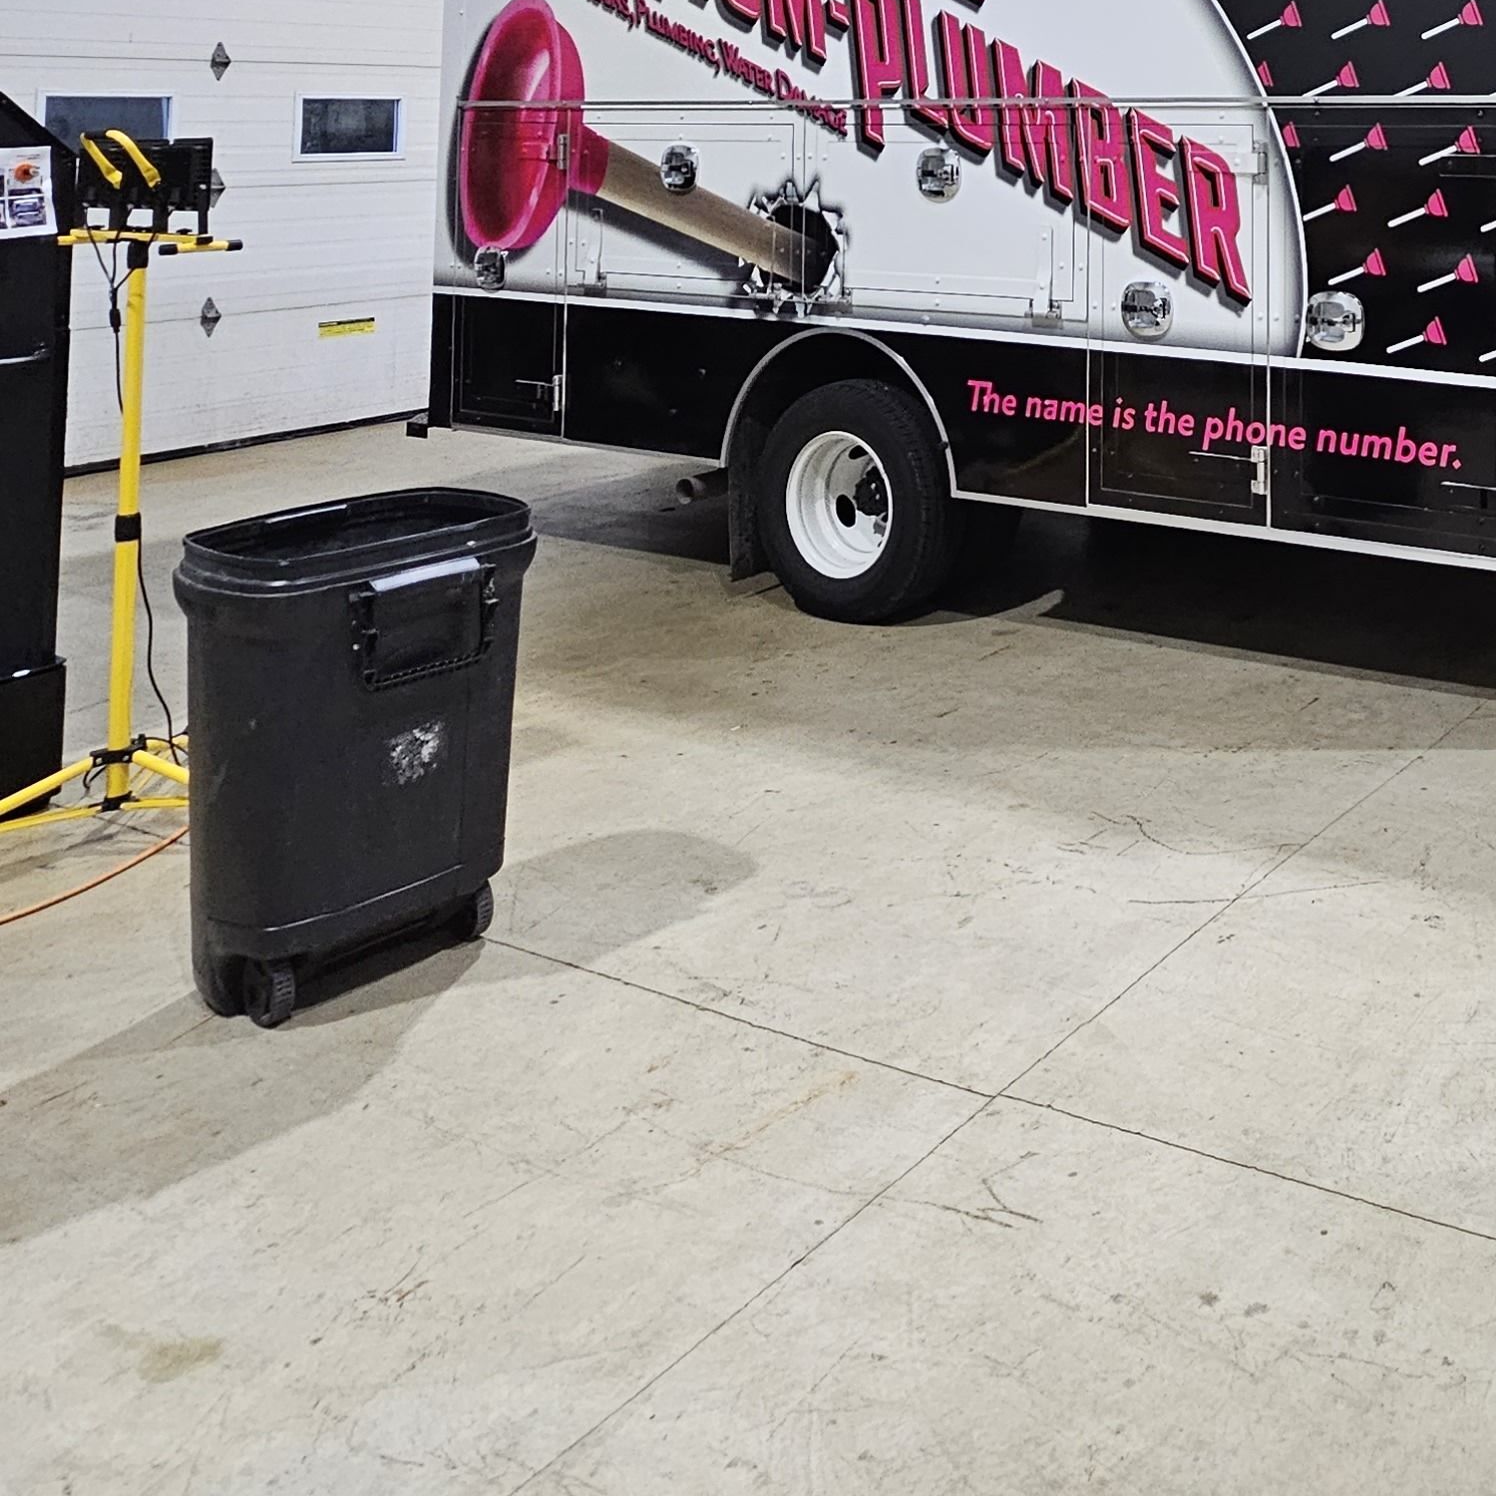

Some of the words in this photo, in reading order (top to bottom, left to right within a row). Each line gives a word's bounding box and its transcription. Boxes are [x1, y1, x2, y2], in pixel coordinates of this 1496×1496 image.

[967, 380, 1017, 416] The
[1025, 397, 1103, 426] name
[1113, 397, 1135, 430] is
[1144, 401, 1194, 436] the
[1203, 408, 1306, 450] phone
[1316, 426, 1463, 471] number.
